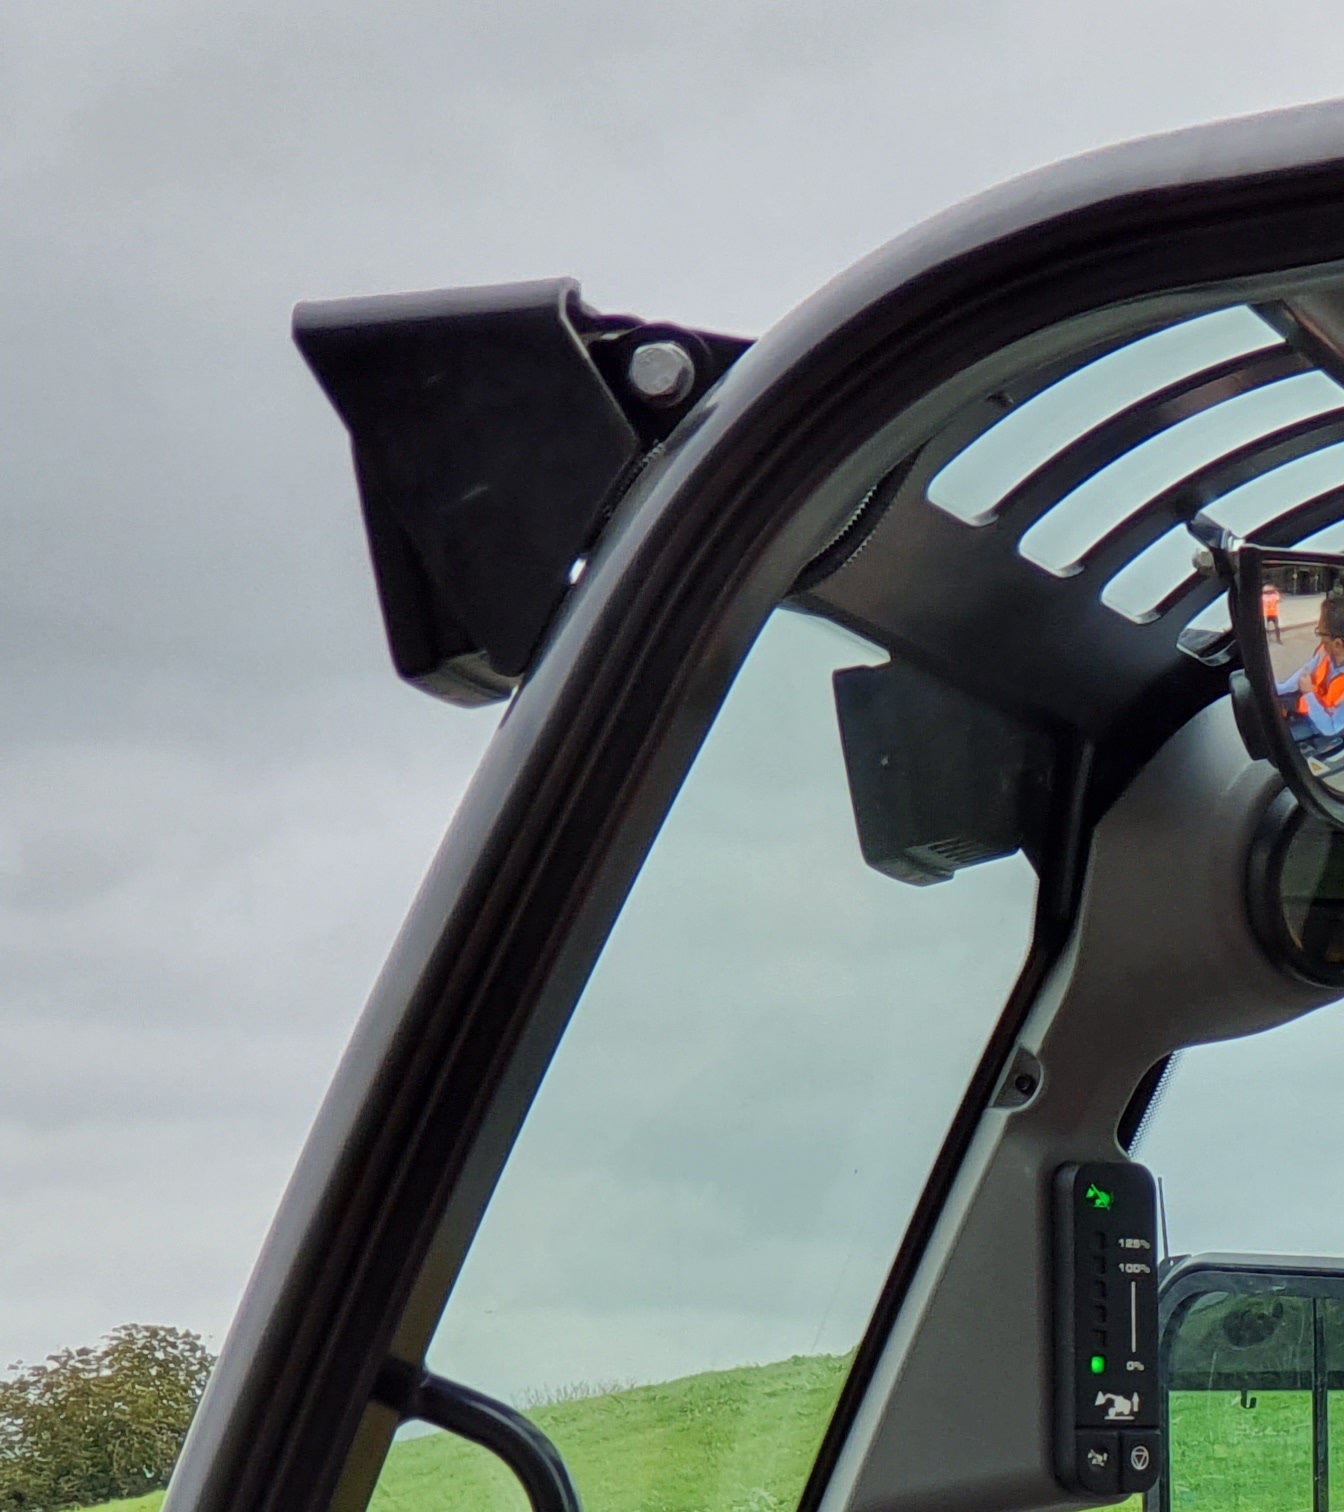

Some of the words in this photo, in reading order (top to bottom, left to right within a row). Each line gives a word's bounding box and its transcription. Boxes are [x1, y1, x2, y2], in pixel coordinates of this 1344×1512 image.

[1118, 1238, 1151, 1249] 125%
[1118, 1263, 1151, 1273] 100%
[1126, 1361, 1145, 1371] 0%
